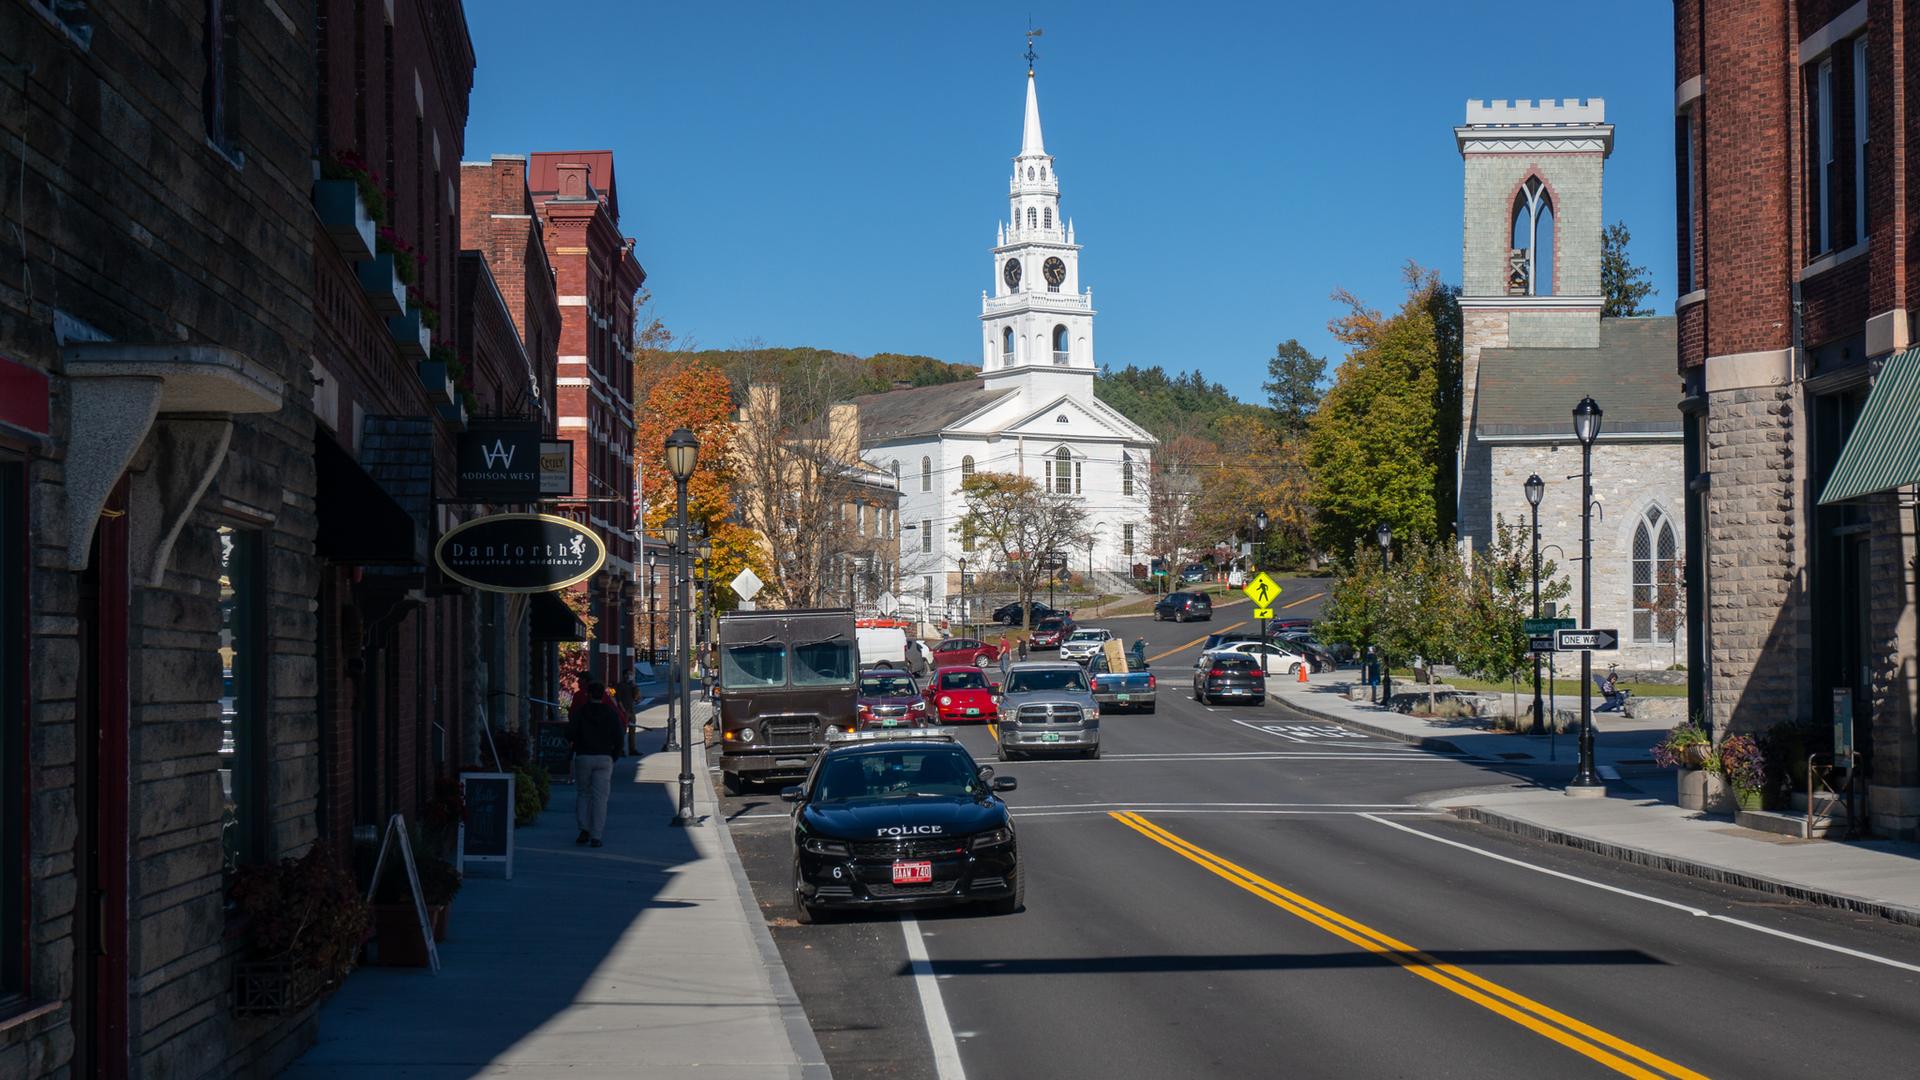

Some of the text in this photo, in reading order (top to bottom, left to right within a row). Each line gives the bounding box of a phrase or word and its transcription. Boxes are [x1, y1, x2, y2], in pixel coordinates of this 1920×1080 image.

[510, 472, 536, 480] WEST
[453, 543, 567, 557] Danforth
[1564, 635, 1600, 643] ONE WAY
[877, 825, 943, 837] POLICE
[833, 867, 842, 879] 6
